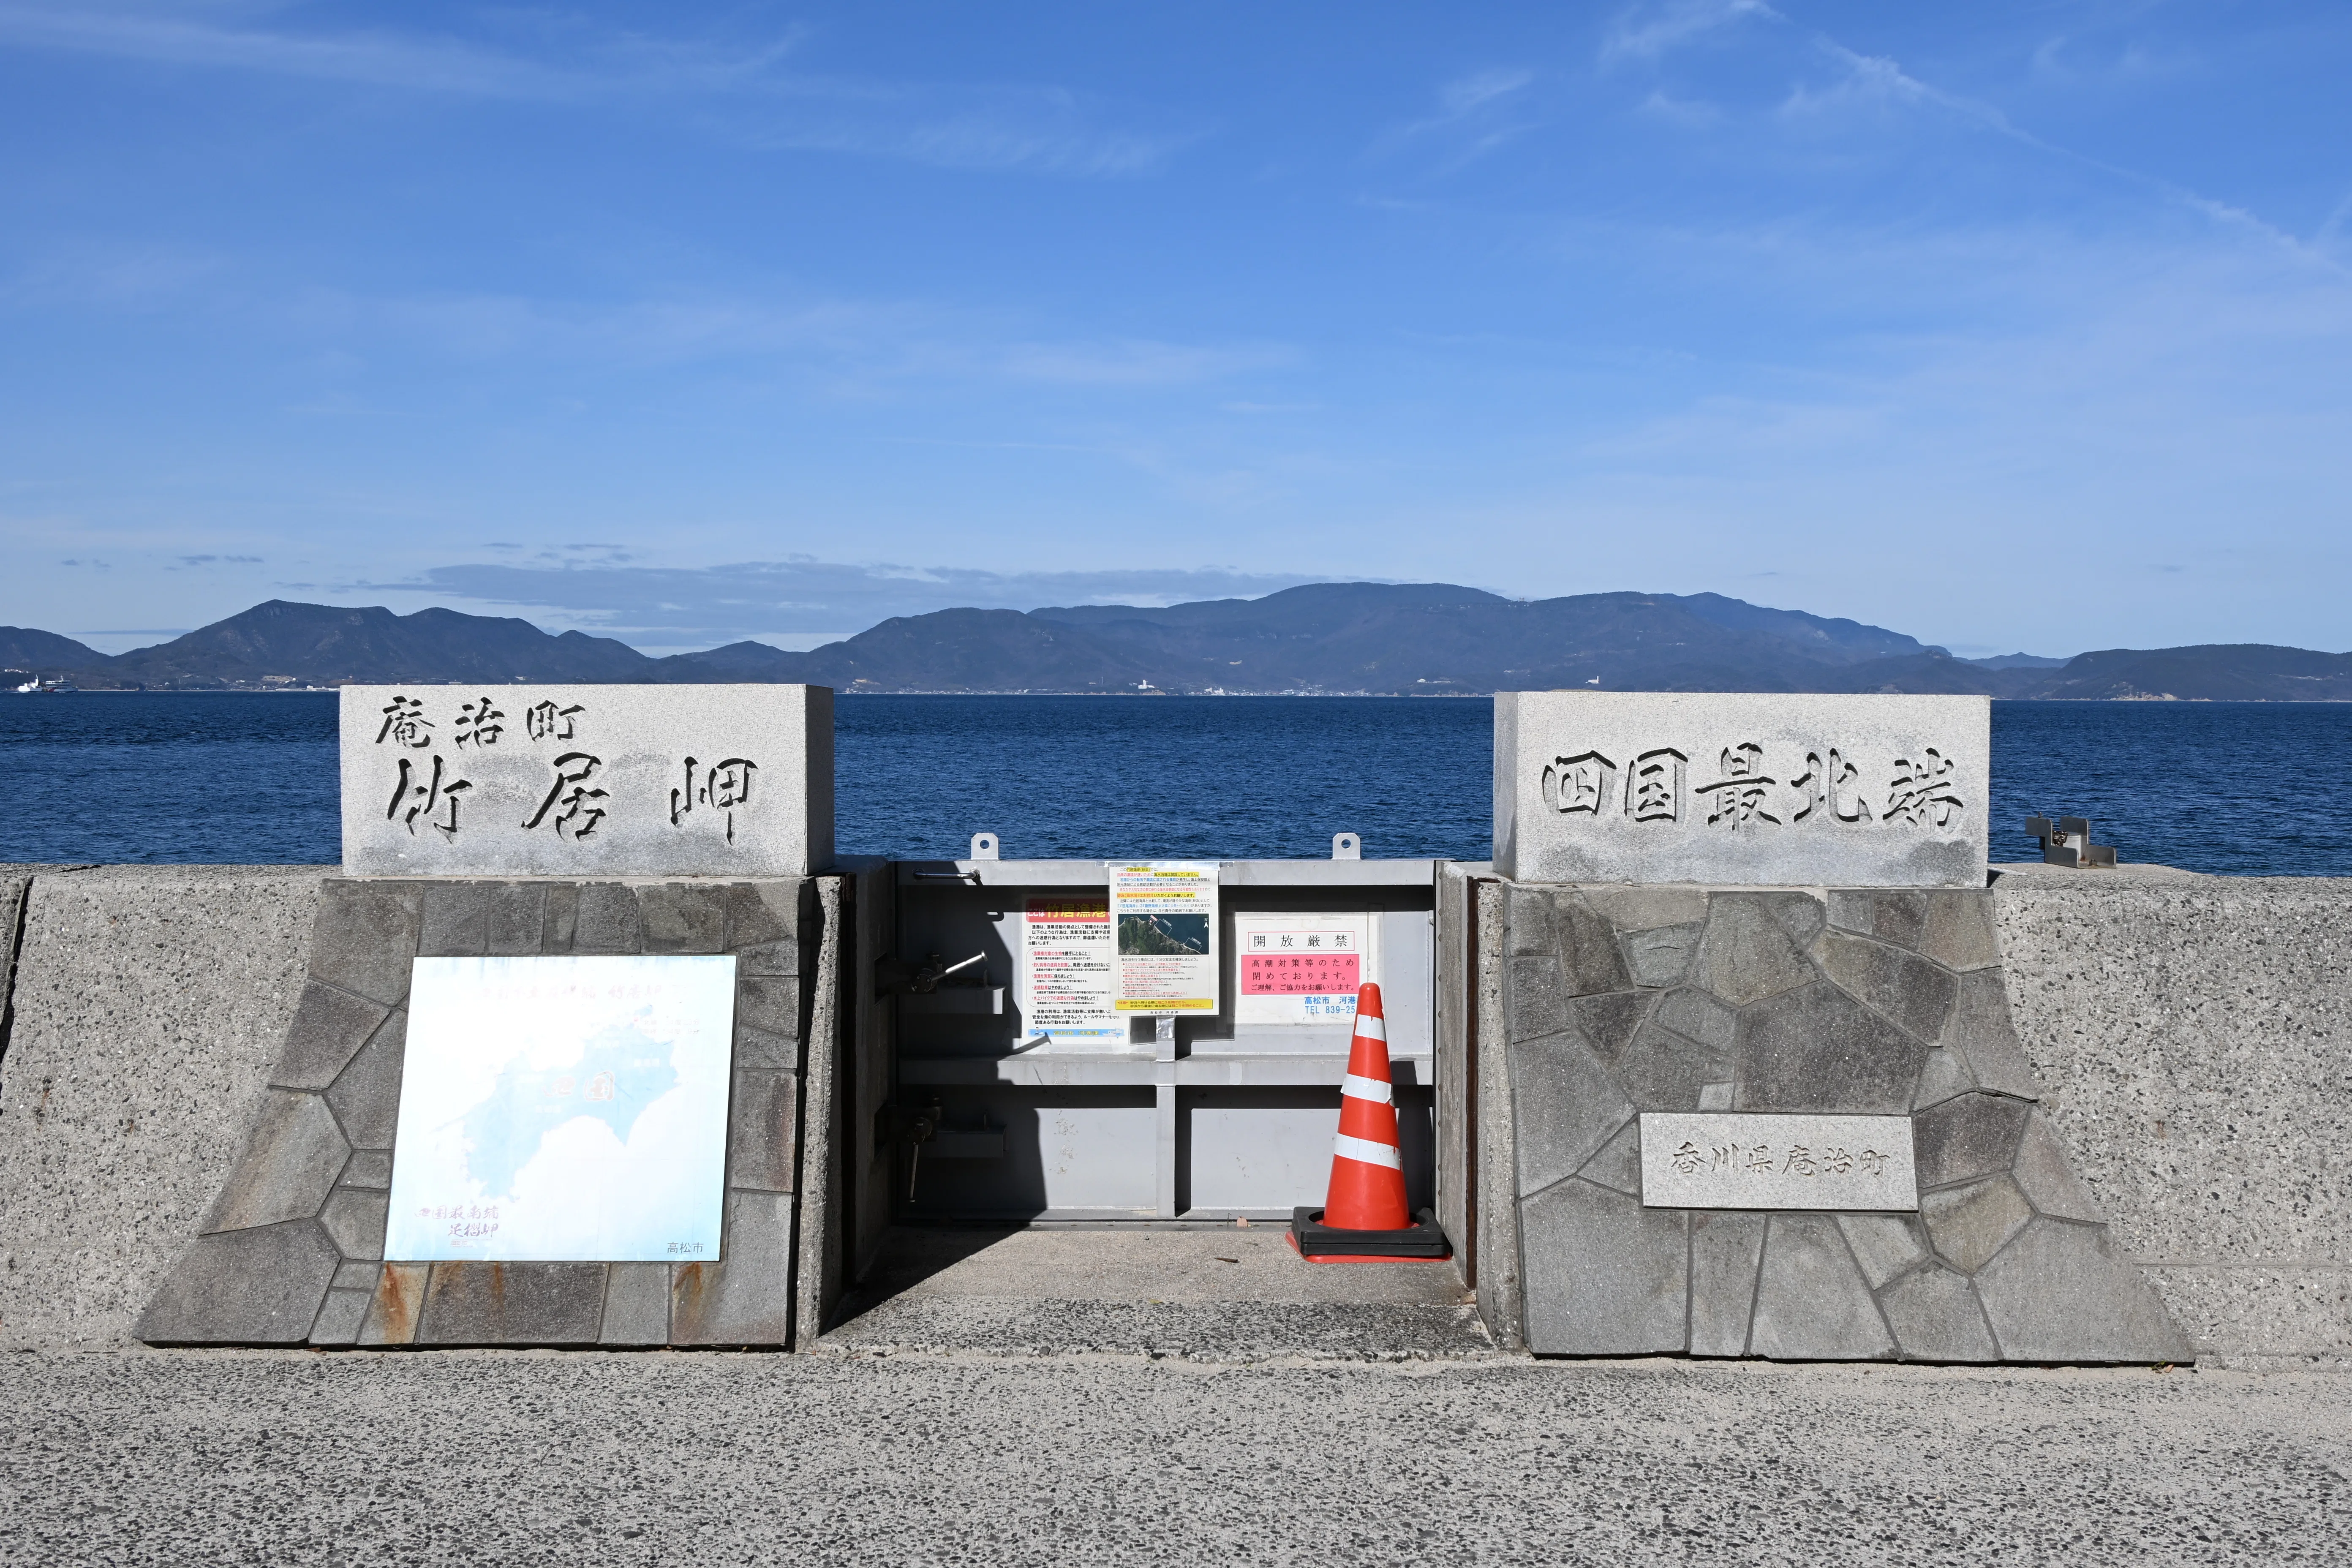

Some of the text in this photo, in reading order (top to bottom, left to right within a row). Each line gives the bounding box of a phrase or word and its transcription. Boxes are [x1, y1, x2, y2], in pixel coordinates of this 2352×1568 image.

[376, 696, 585, 749] 庵治町
[1542, 742, 1964, 831] 四国最北端
[387, 752, 759, 846] 竹居岬
[1027, 903, 1110, 918] ここは竹居漁港
[1254, 934, 1347, 947] 開放厳禁
[1252, 959, 1354, 967] 高潮対策等のため
[1252, 972, 1345, 980] 閉めております。
[1339, 996, 1358, 1004] 河港
[1305, 1005, 1355, 1014] TEL 839-25
[1671, 1142, 1890, 1177] 香川県庵治町
[667, 1242, 704, 1253] 高松市
